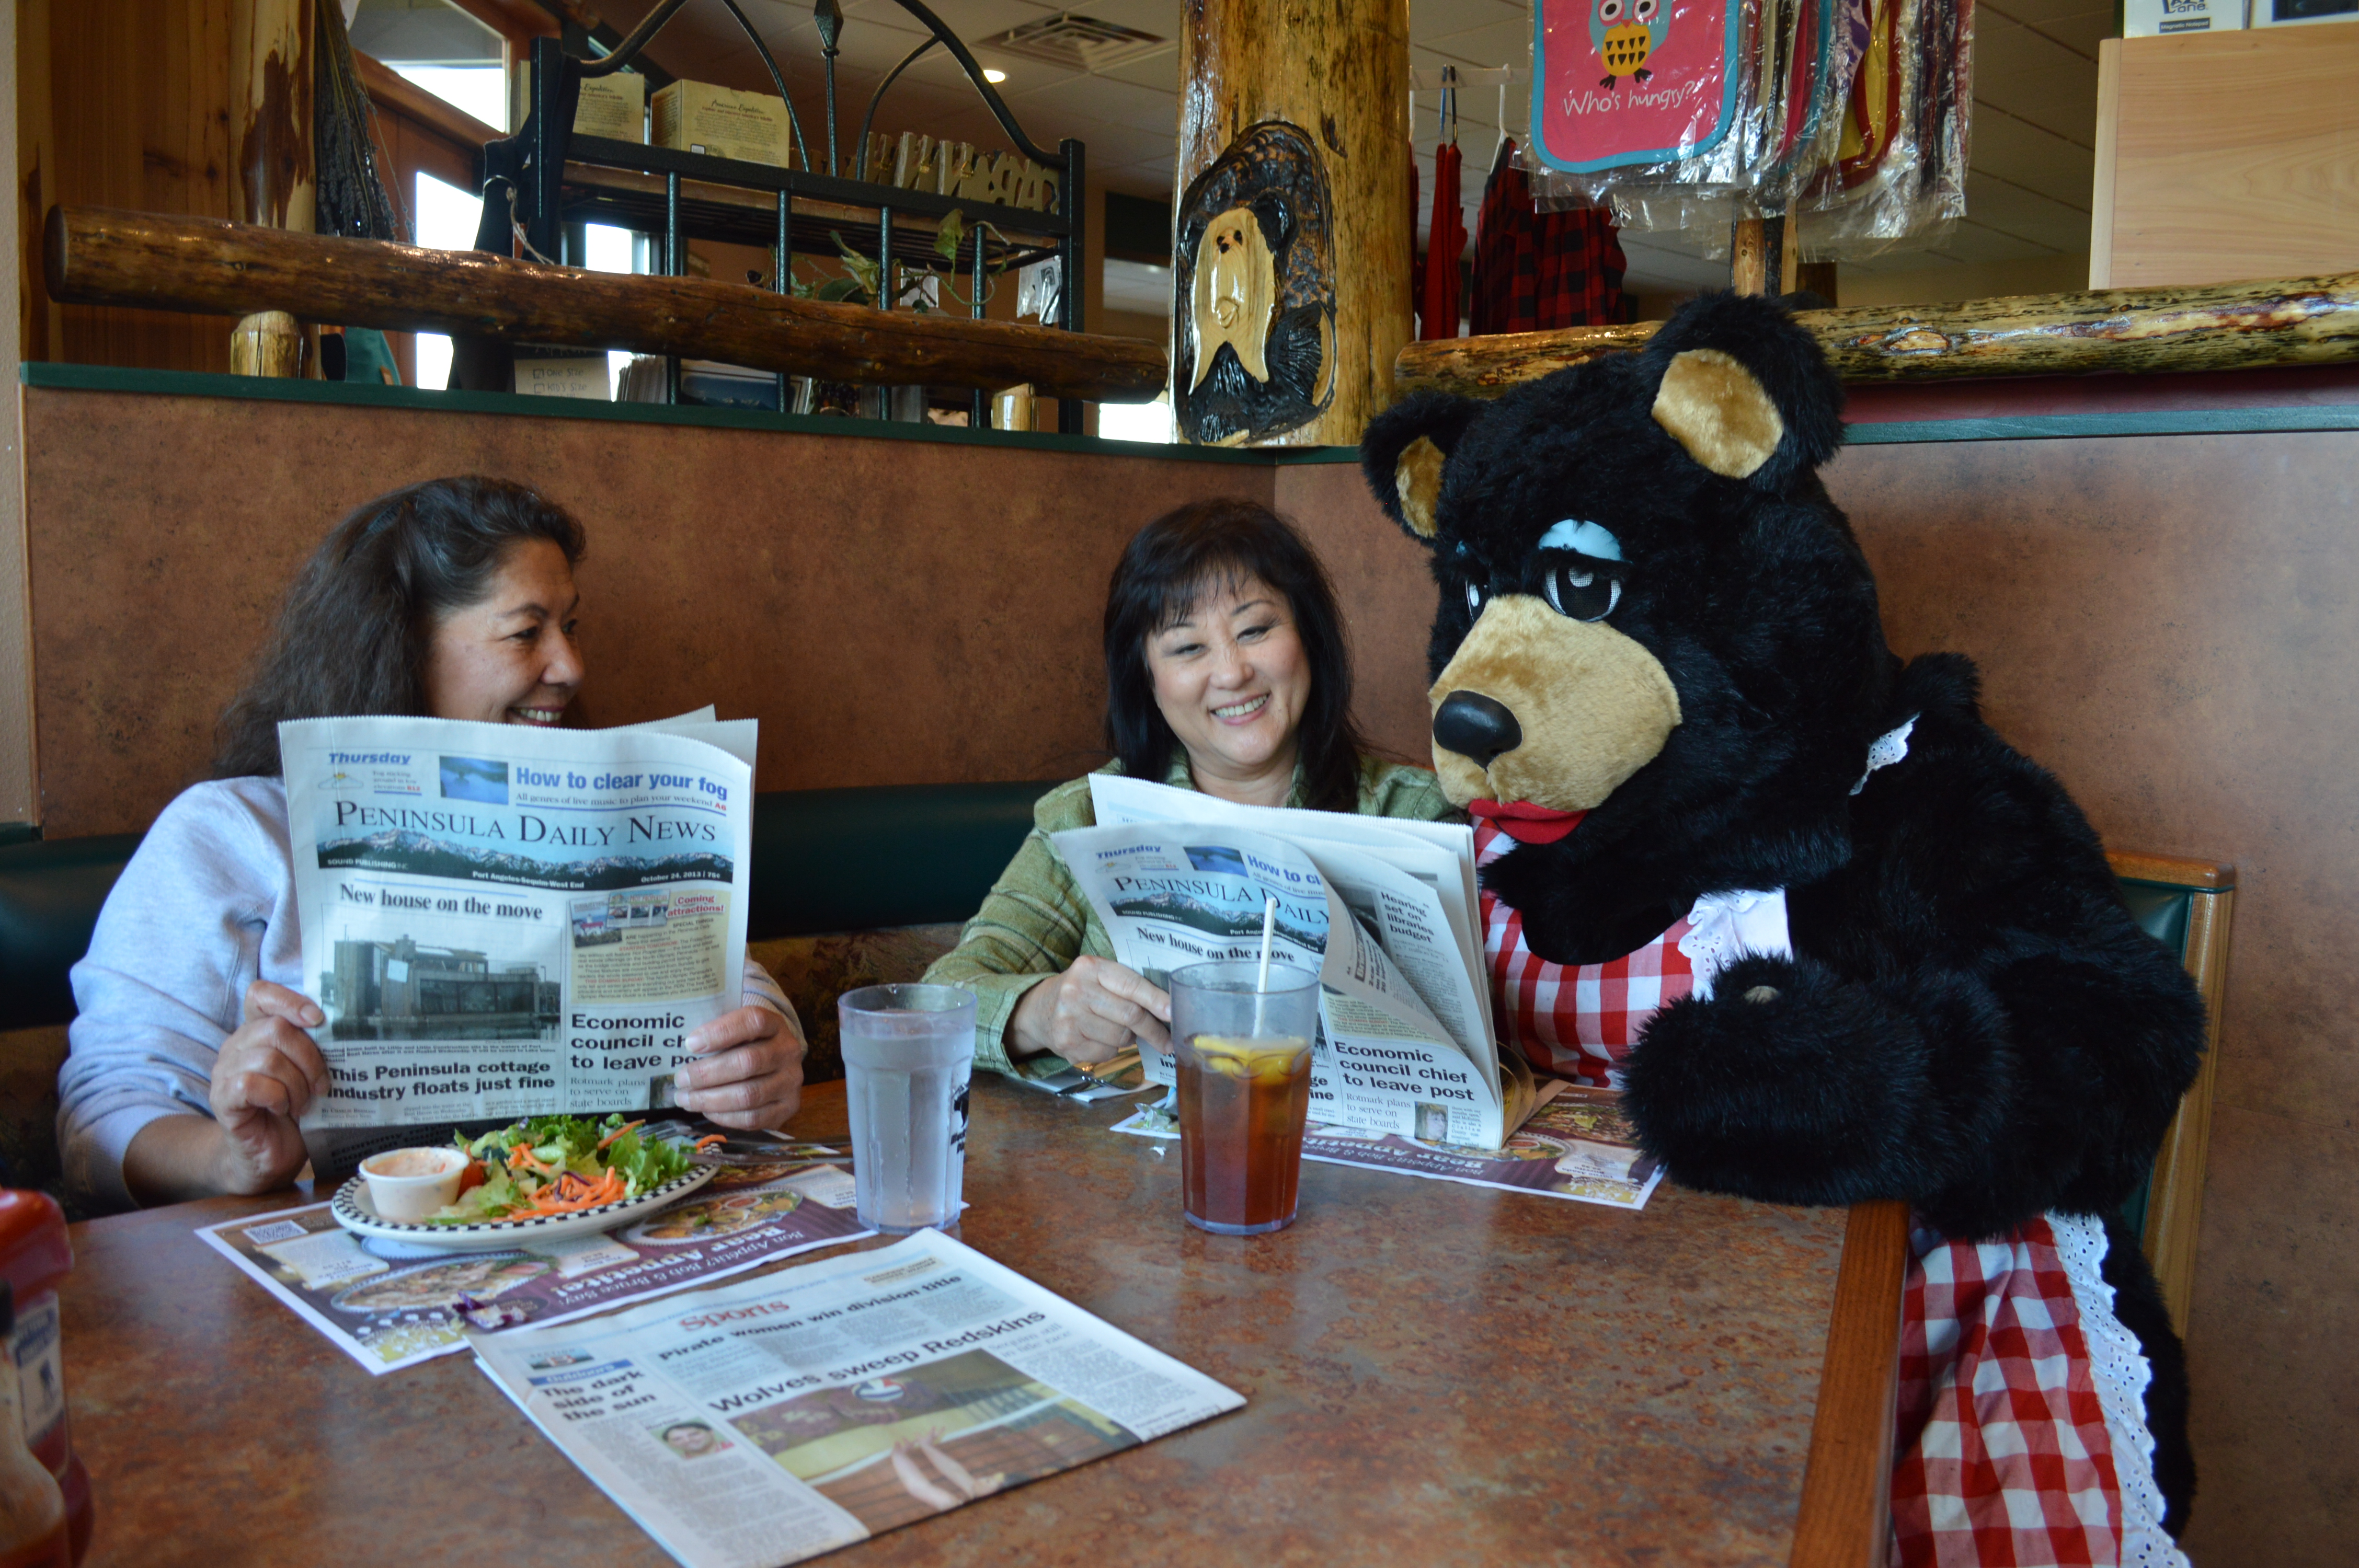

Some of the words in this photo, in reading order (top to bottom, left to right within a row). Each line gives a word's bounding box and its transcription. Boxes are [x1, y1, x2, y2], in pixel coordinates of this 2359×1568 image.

[1563, 90, 1621, 117] Who's
[1628, 80, 1696, 111] hungry?
[328, 753, 411, 765] Thursday
[517, 767, 560, 787] How
[567, 771, 587, 789] to
[593, 772, 643, 790] clear
[649, 774, 693, 790] your
[699, 777, 728, 801] fog
[516, 793, 528, 801] All
[530, 794, 559, 804] genres
[620, 796, 628, 804] to
[631, 793, 649, 805] plan
[651, 795, 671, 804] your
[673, 795, 712, 807] weekend
[715, 802, 727, 811] A6
[334, 800, 506, 839] PENINSULA
[518, 814, 615, 846] DAILY
[627, 814, 715, 844] NEWS
[1095, 844, 1161, 859] Thursday
[473, 870, 489, 879] Port
[641, 872, 669, 883] October
[1247, 855, 1280, 877] How
[1283, 869, 1301, 882] to
[677, 894, 715, 905] Coming
[1114, 877, 1253, 903] PENINSULA
[340, 883, 376, 905] New
[381, 888, 431, 910] house
[436, 896, 459, 912] on
[462, 892, 491, 915] the
[495, 902, 543, 920] move
[668, 905, 725, 917] attractions!
[1381, 891, 1427, 918] Hearing
[1384, 903, 1404, 915] set
[1407, 912, 1422, 922] on
[1387, 913, 1435, 936] libraries
[1389, 924, 1433, 943] budget
[1136, 926, 1166, 945] New
[1170, 934, 1204, 956] house
[1207, 948, 1224, 960] on
[1227, 943, 1252, 959] the
[1308, 943, 1319, 952] End
[572, 1012, 685, 1030] Economic
[571, 1034, 654, 1050] council
[1334, 1041, 1434, 1063] Economic
[329, 1067, 369, 1082] This
[375, 1062, 471, 1080] Peninsula
[477, 1061, 551, 1075] cottage
[570, 1055, 594, 1068] to
[604, 1055, 661, 1069] leave
[671, 1055, 705, 1068] po
[1339, 1059, 1411, 1077] council
[1418, 1067, 1468, 1084] chief
[413, 1080, 469, 1096] floats
[474, 1078, 512, 1094] just
[518, 1076, 555, 1089] fine
[570, 1077, 613, 1087] Rotmark
[617, 1077, 646, 1088] plans
[570, 1088, 580, 1096] to
[1343, 1073, 1364, 1086] to
[1370, 1076, 1423, 1094] leave
[1430, 1086, 1475, 1101] post
[570, 1099, 593, 1108] state
[597, 1097, 632, 1106] boards
[1309, 1089, 1334, 1101] ine
[1346, 1092, 1383, 1105] Rotmark
[1387, 1098, 1411, 1108] plans
[1347, 1103, 1356, 1111] to
[1359, 1106, 1383, 1115] serve
[1347, 1114, 1367, 1124] state
[1369, 1116, 1400, 1129] boards
[1416, 1153, 1486, 1169] Bear
[711, 1226, 785, 1252] Bear
[772, 1230, 804, 1243] Bon
[658, 1335, 724, 1360] Pirate
[730, 1319, 803, 1338] women
[808, 1308, 843, 1324] win
[846, 1288, 920, 1312] division
[921, 1275, 961, 1291] title
[680, 1300, 790, 1332] Sports
[708, 1373, 822, 1412] Wolves
[829, 1351, 920, 1380] sweep
[921, 1311, 1046, 1354] Redskins
[541, 1385, 584, 1398] The
[591, 1369, 644, 1390] dark
[552, 1394, 604, 1410] side
[611, 1385, 636, 1397] of
[562, 1408, 604, 1421] the
[612, 1394, 657, 1410] sun
